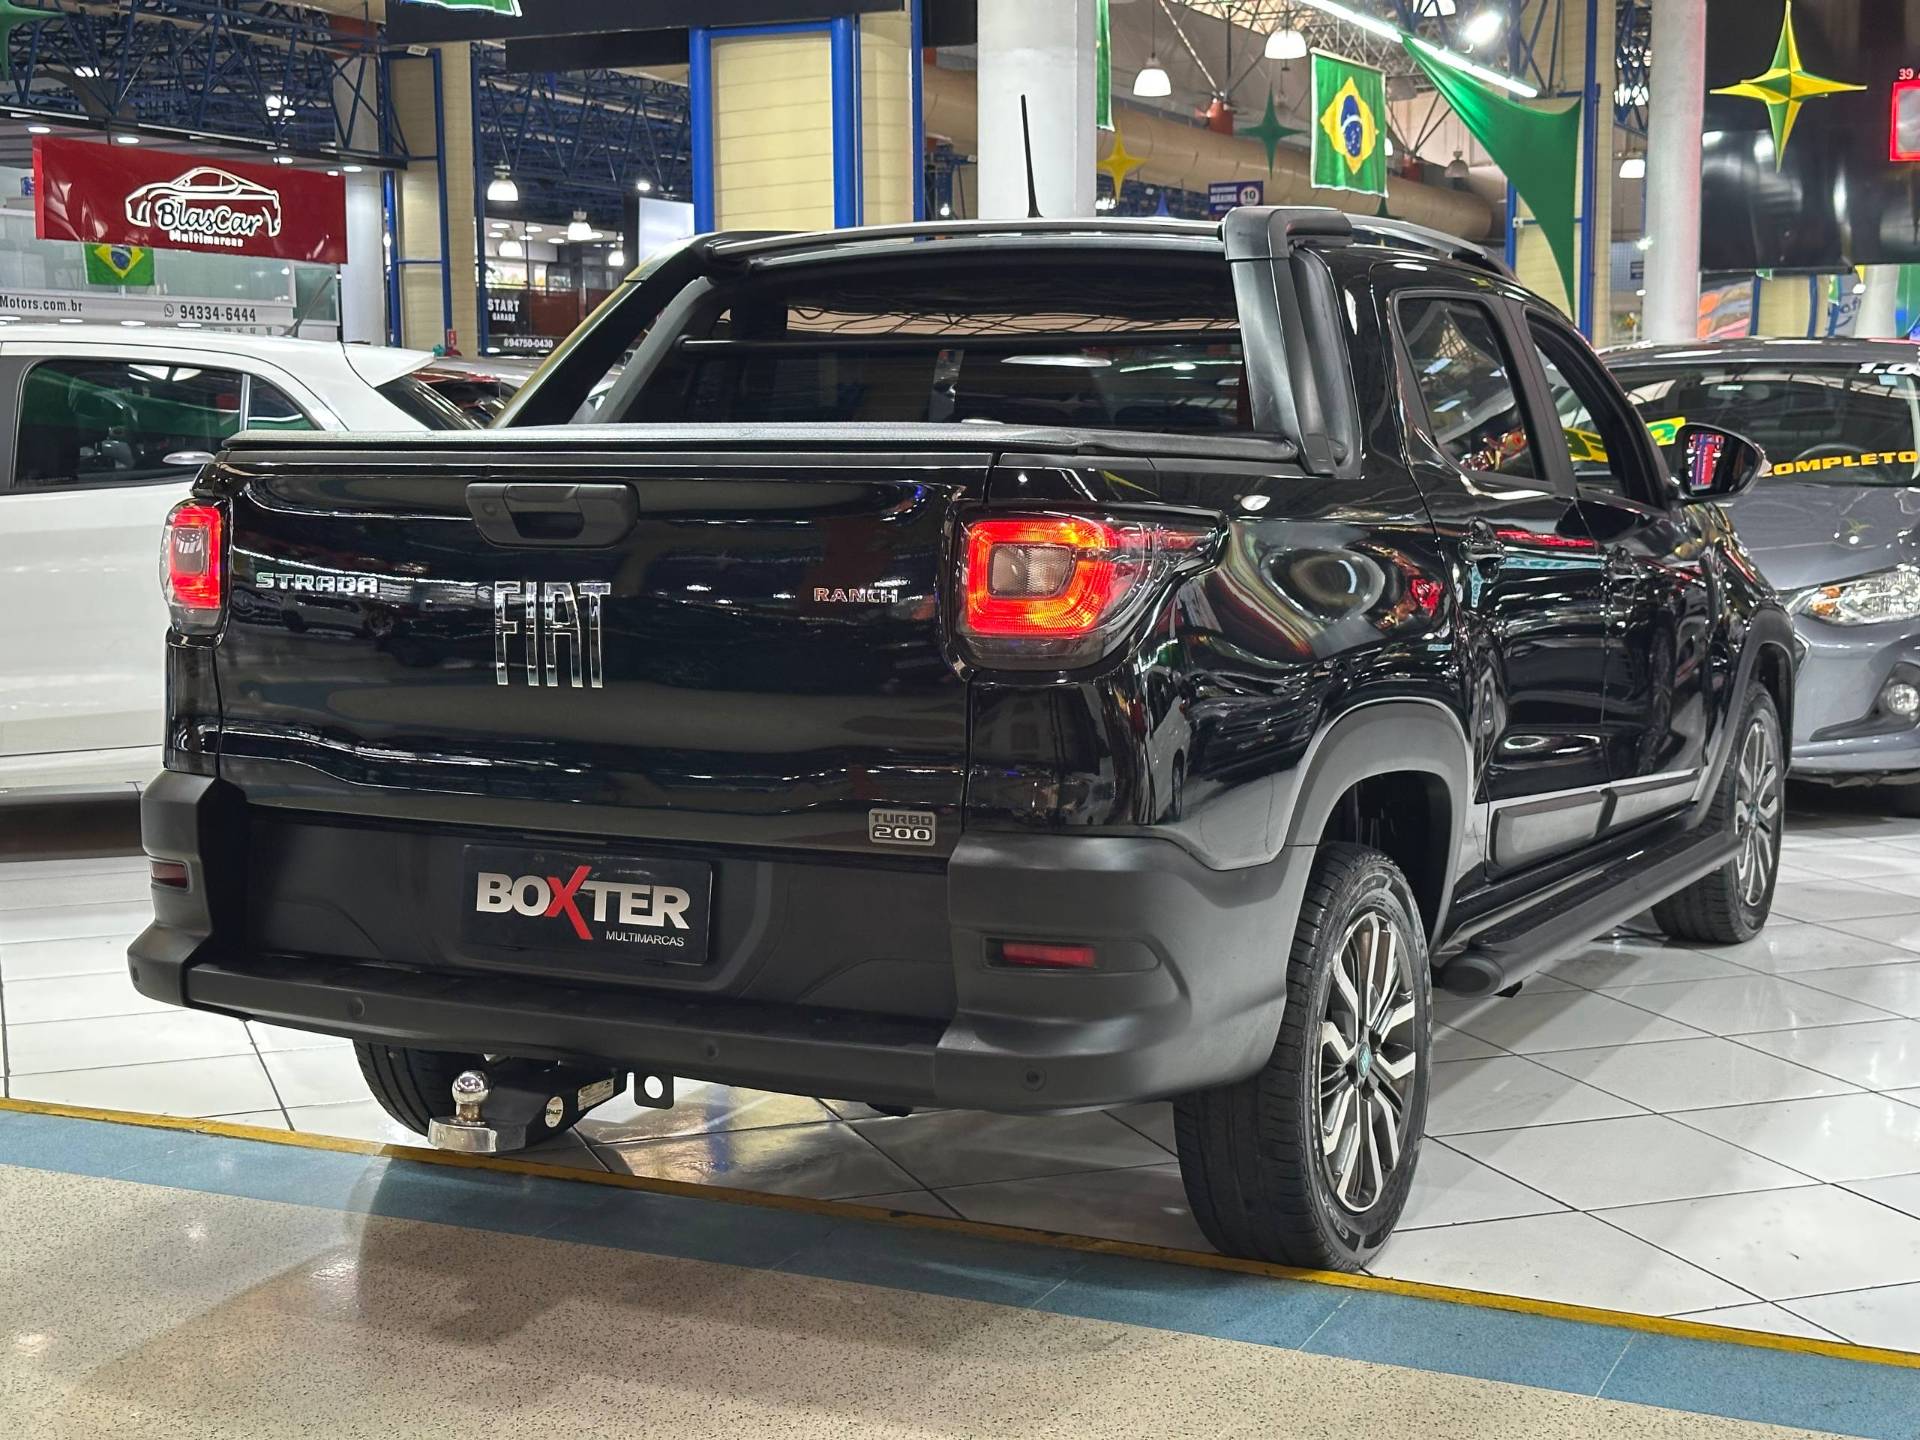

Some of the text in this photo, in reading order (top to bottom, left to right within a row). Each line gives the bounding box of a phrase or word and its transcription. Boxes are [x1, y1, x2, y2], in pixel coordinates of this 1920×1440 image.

[155, 197, 263, 236] BlasCar
[169, 229, 244, 247] Multimarcas
[180, 304, 256, 322] 94334-6444
[487, 298, 520, 312] START
[491, 312, 516, 322] GARAGE
[1762, 451, 1919, 478] OMPLETO
[255, 572, 379, 594] STRADA
[813, 586, 899, 604] RANCH
[494, 580, 612, 689] FIAT
[871, 812, 934, 827] TURBO
[874, 826, 931, 841] 200
[476, 865, 693, 941] BOXTER
[605, 930, 685, 948] MULTIMARCAS
